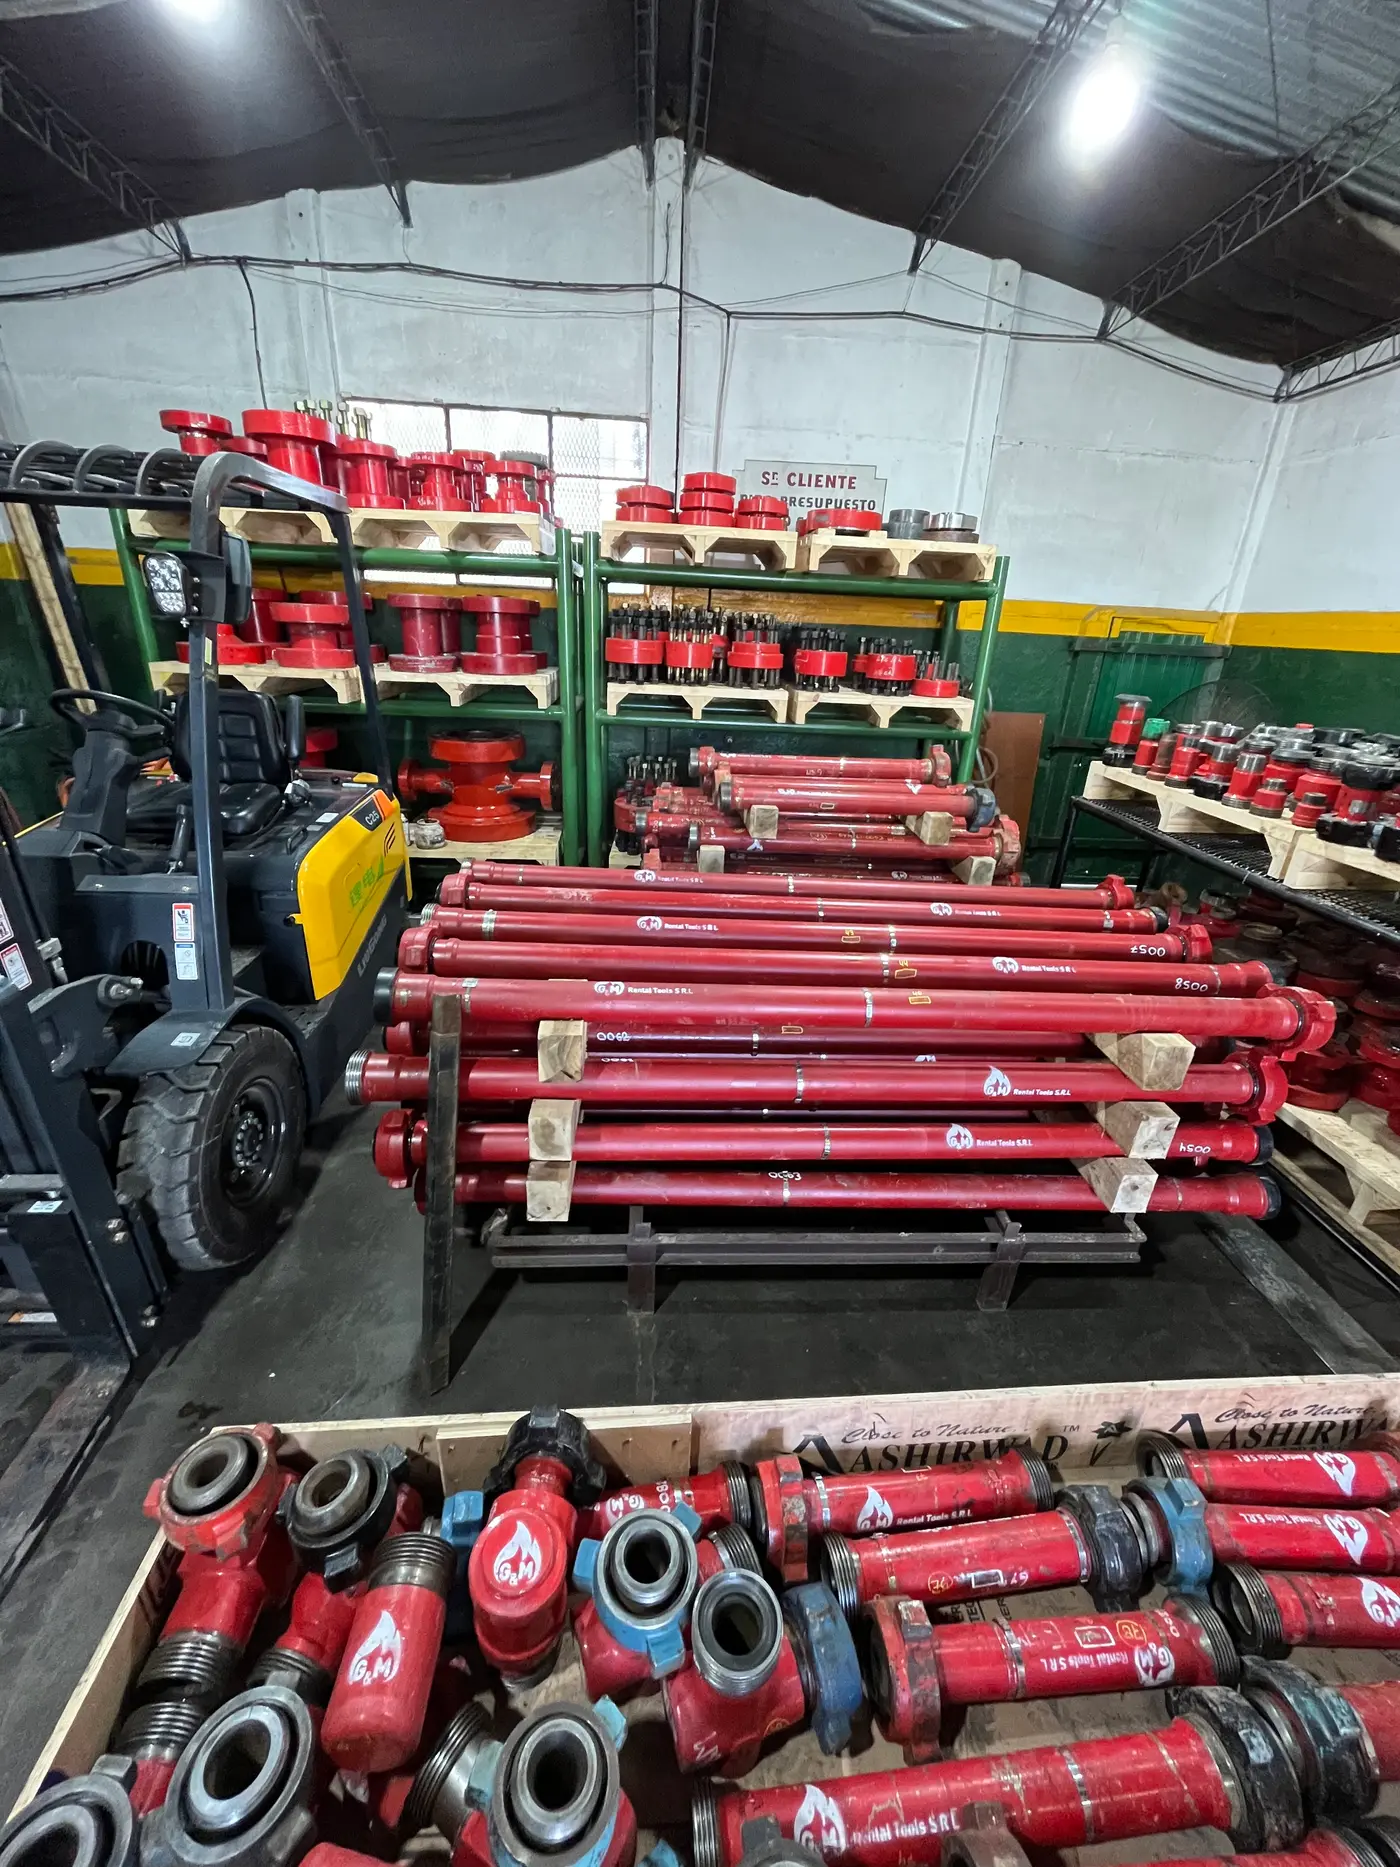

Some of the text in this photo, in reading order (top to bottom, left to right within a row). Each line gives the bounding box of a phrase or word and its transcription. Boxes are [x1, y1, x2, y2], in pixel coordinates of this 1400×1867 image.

[787, 472, 857, 489] CLIENTE
[365, 811, 380, 826] C25
[1013, 1088, 1034, 1096] Rental
[1035, 1088, 1053, 1096] Tools
[976, 1139, 997, 1147] Rental
[998, 1139, 1015, 1147] Tools
[1215, 1407, 1272, 1423] Close
[1280, 1406, 1298, 1418] to
[841, 1426, 903, 1444] Close
[912, 1427, 931, 1438] to
[1257, 1453, 1284, 1462] Tools
[1285, 1453, 1312, 1462] Rental
[896, 1518, 924, 1526] Rental
[926, 1512, 949, 1522] Tools
[1265, 1513, 1292, 1524] Tools
[1290, 1514, 1322, 1525] Rental
[499, 1561, 535, 1585] G&M
[1068, 1655, 1095, 1669] Tools
[1096, 1651, 1128, 1666] Rental
[352, 1656, 393, 1686] G&M
[851, 1827, 892, 1846] Rental
[893, 1817, 927, 1838] Tools
